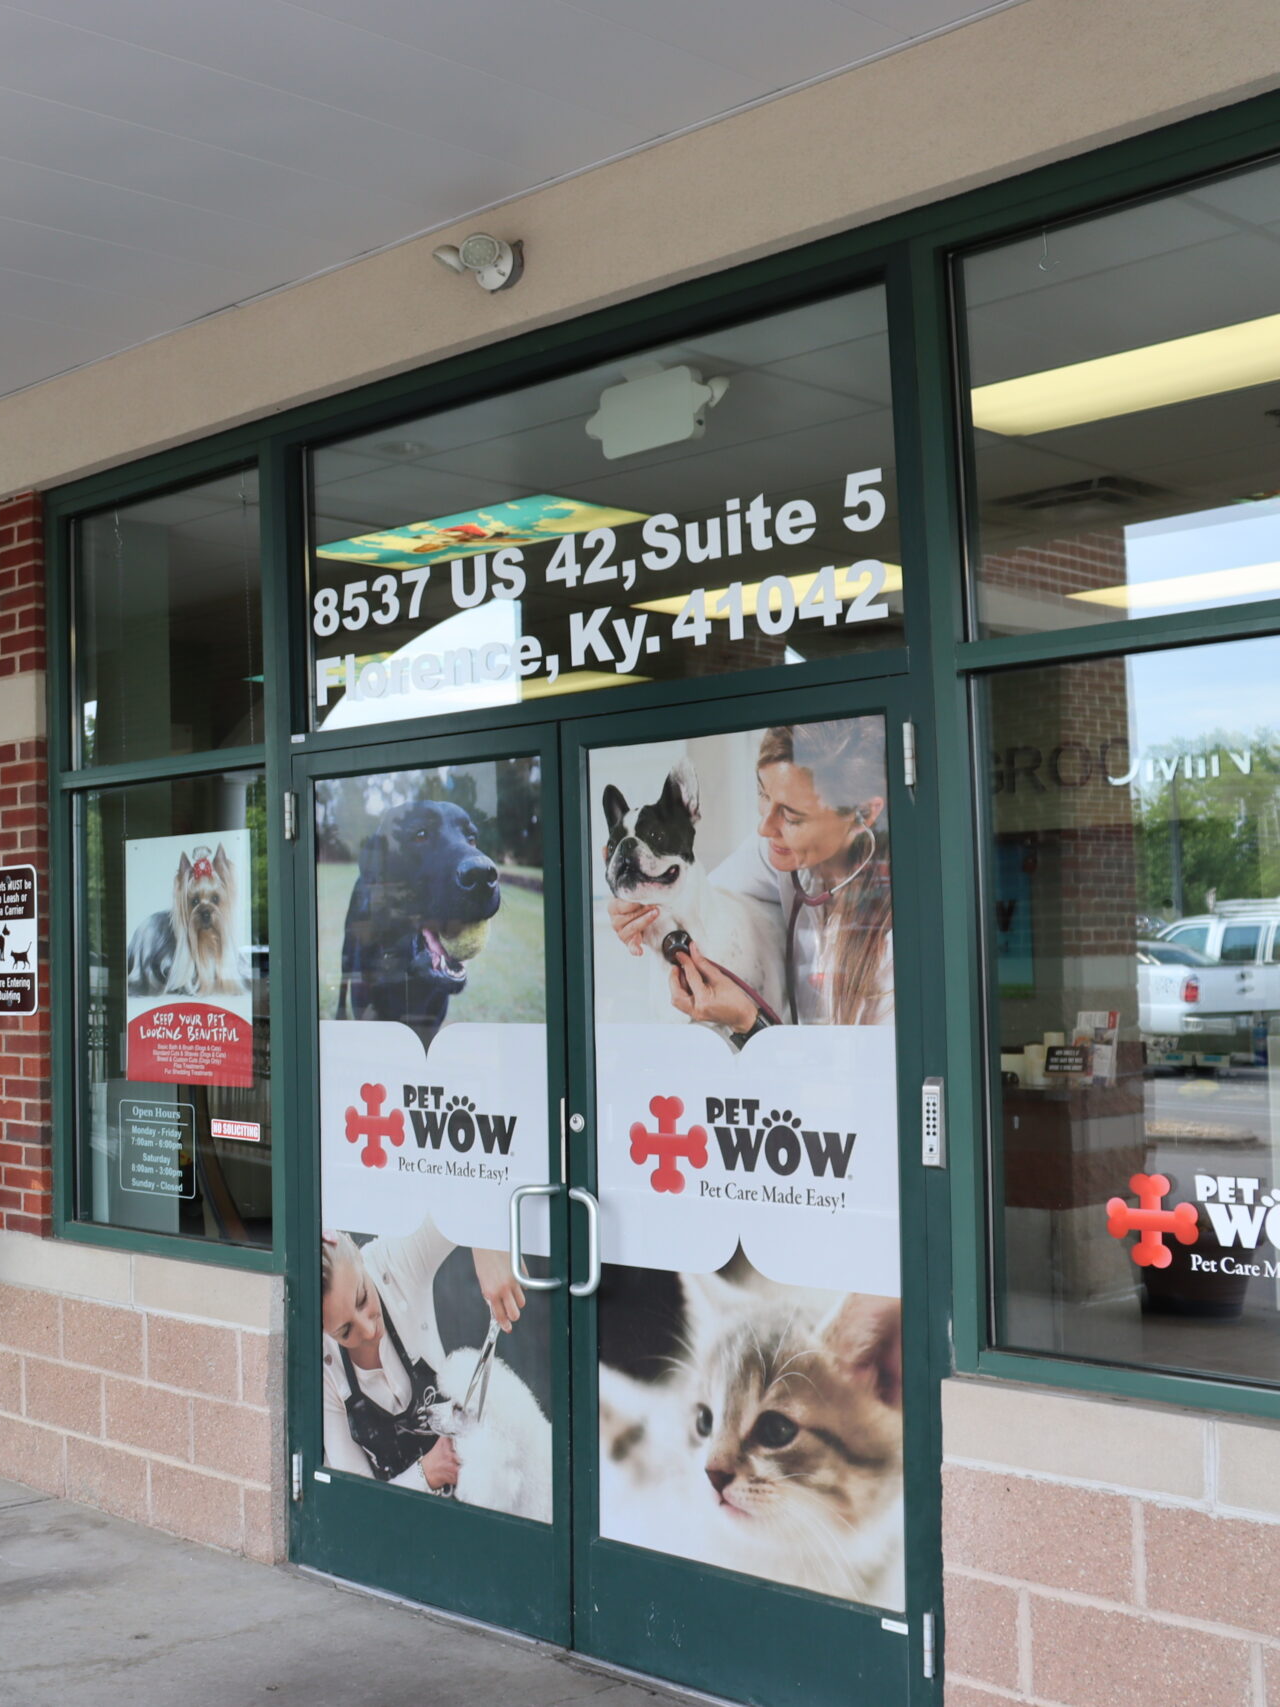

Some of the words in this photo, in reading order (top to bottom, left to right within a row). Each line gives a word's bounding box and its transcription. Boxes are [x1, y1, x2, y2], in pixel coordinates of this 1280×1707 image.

[313, 566, 431, 637] 8537
[451, 546, 526, 610] US
[842, 466, 887, 533] 5
[671, 559, 890, 648] 41042
[7, 879, 23, 891] MUST
[24, 879, 32, 889] be
[3, 892, 20, 904] Leash
[21, 893, 28, 902] or
[0, 907, 4, 916] a
[4, 905, 24, 916] Carrier
[6, 977, 31, 991] Entering
[152, 1012, 174, 1026] KEEP
[179, 1013, 202, 1027] YOUR
[207, 1013, 226, 1027] PET
[403, 1084, 444, 1110] PET
[132, 1105, 153, 1118] Open
[155, 1107, 180, 1119] Hours
[705, 1096, 760, 1126] PET
[131, 1125, 156, 1137] Monday
[161, 1128, 182, 1140] Friday
[212, 1122, 222, 1134] NO
[222, 1123, 258, 1139] SOLICITING
[409, 1095, 517, 1156] WOW
[131, 1137, 154, 1147] 7:00am
[713, 1109, 857, 1179] WOW
[142, 1152, 170, 1166] Saturday
[131, 1163, 154, 1174] 8:00am
[159, 1166, 182, 1177] 3:00pm
[398, 1156, 416, 1172] Pet
[417, 1158, 443, 1175] Care
[445, 1160, 476, 1178] Made
[478, 1163, 509, 1185] Easy!
[131, 1177, 155, 1190] Sunday
[160, 1180, 183, 1192] Closed
[1194, 1174, 1259, 1205] PET
[700, 1180, 721, 1198] Pet
[725, 1182, 758, 1201] Care
[762, 1185, 802, 1205] Made
[805, 1188, 846, 1214] Easy!
[1190, 1253, 1217, 1273] Pet
[1220, 1256, 1260, 1277] Care
